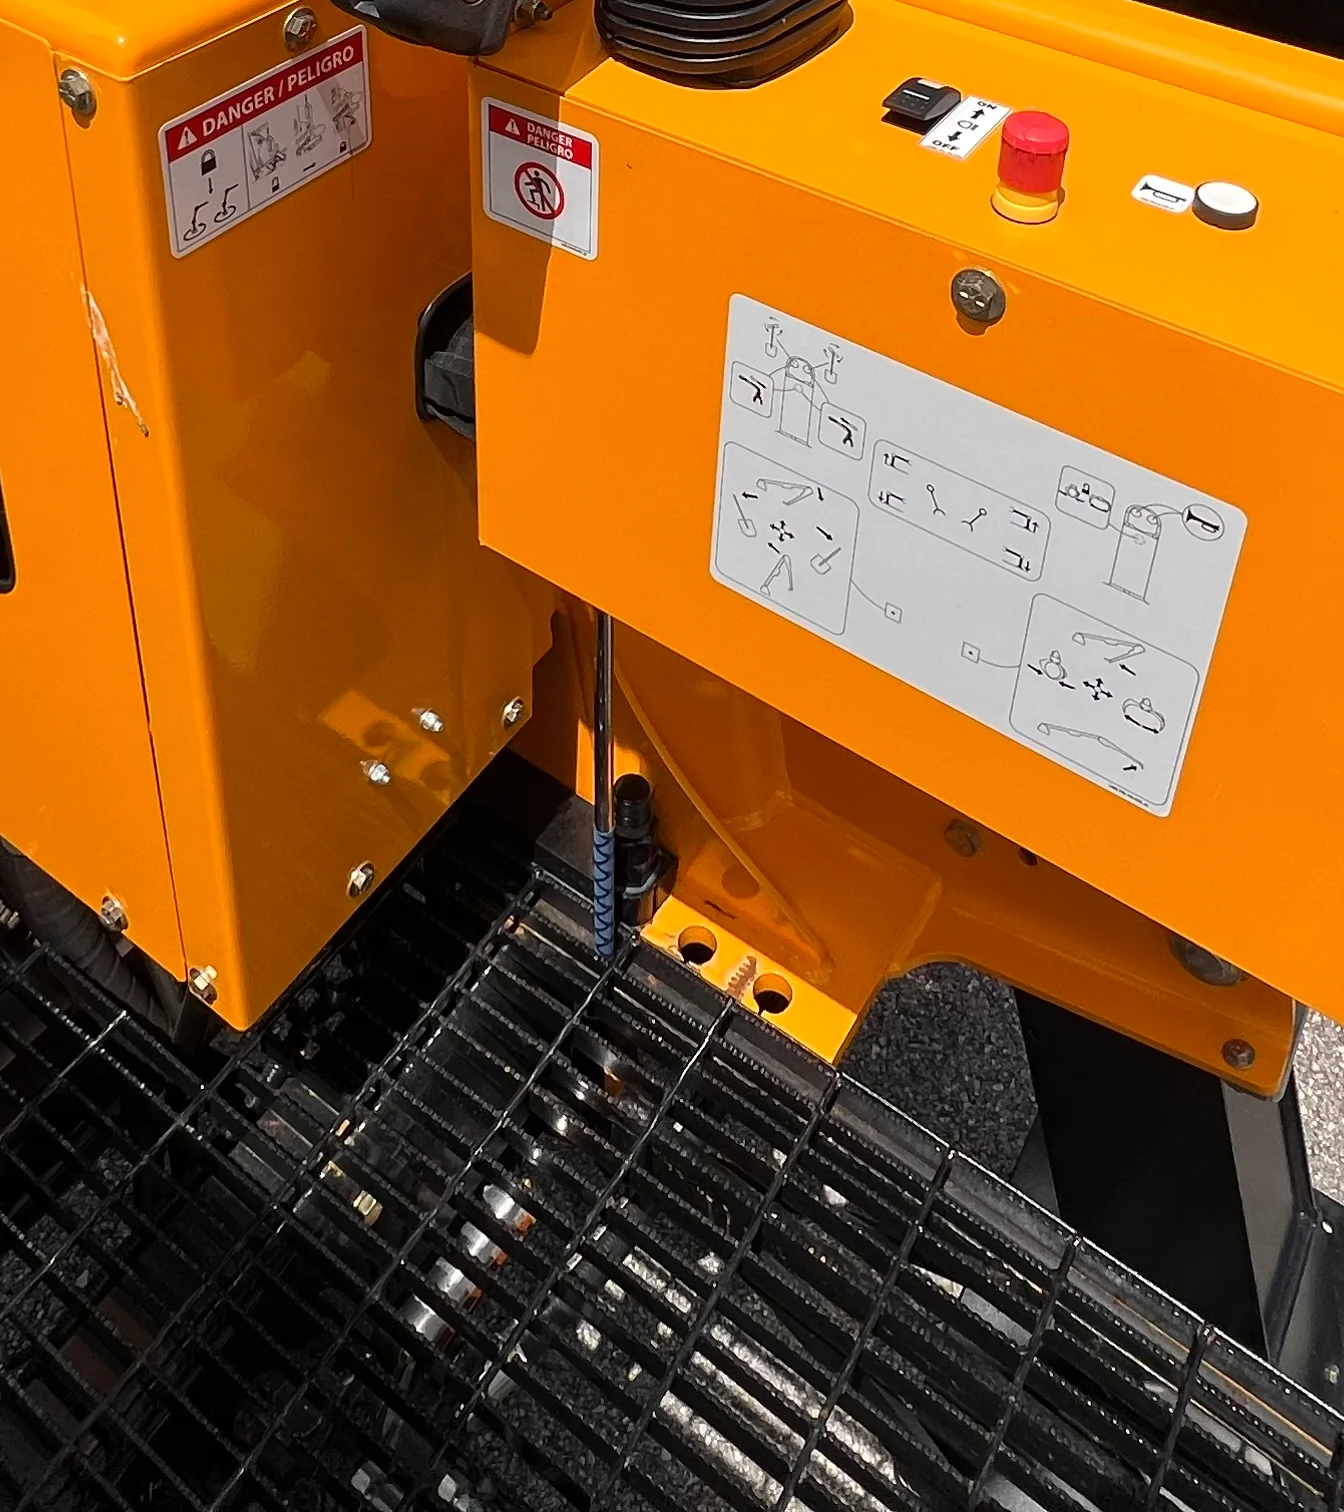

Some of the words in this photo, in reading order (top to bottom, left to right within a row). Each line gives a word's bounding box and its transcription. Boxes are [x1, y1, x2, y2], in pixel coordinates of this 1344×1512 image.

[202, 86, 275, 137] DANGER
[287, 45, 354, 92] PELIGRO
[977, 100, 997, 110] ON
[527, 122, 573, 148] DANGER
[527, 134, 574, 159] PELIGRO
[932, 139, 960, 151] OFF
